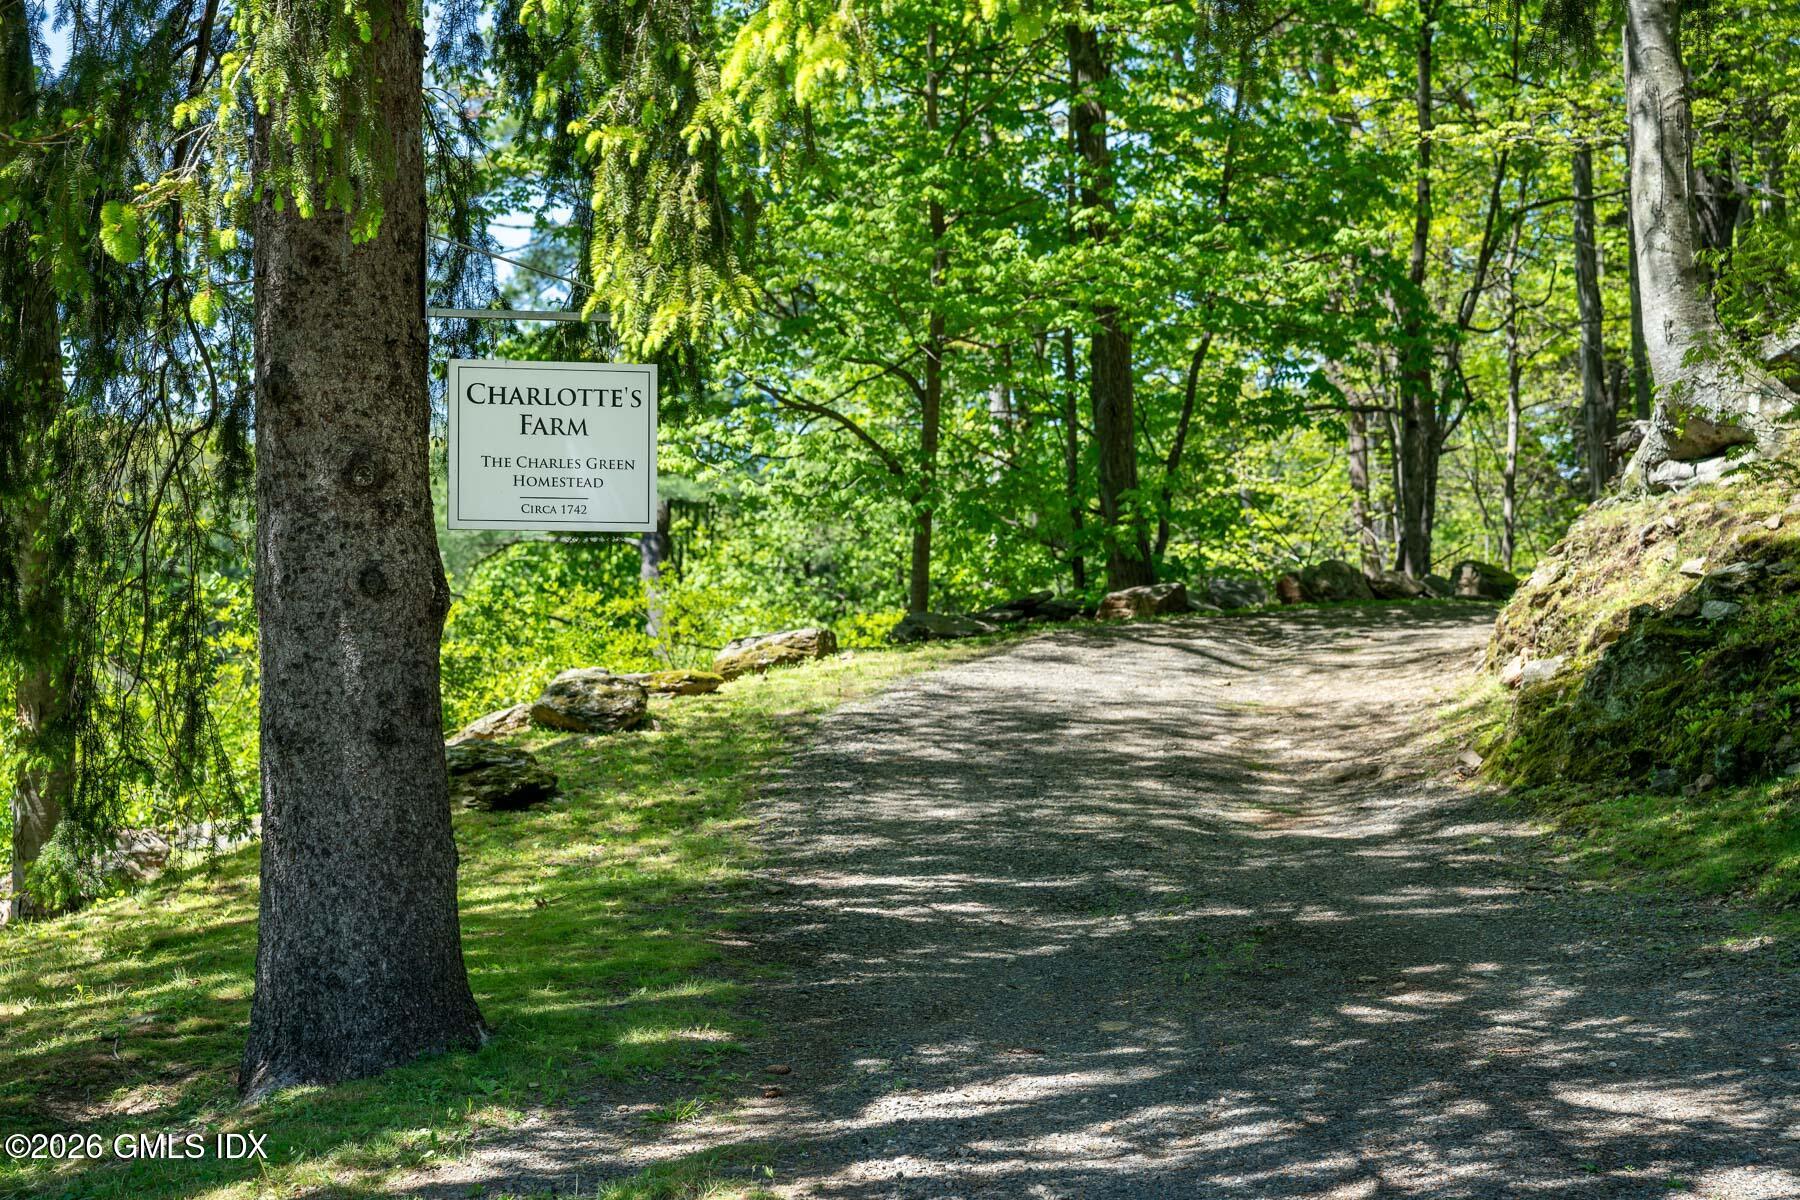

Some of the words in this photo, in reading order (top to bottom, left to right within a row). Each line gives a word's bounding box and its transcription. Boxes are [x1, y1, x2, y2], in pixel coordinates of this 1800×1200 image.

[466, 382, 642, 408] CHARLOTTE'S
[519, 413, 589, 436] FARM
[481, 455, 512, 468] THE
[516, 455, 581, 470] CHARLES
[586, 457, 635, 470] GREEN
[513, 474, 604, 488] HOMESTEAD
[521, 503, 557, 514] CIRCA
[561, 504, 588, 515] 1742
